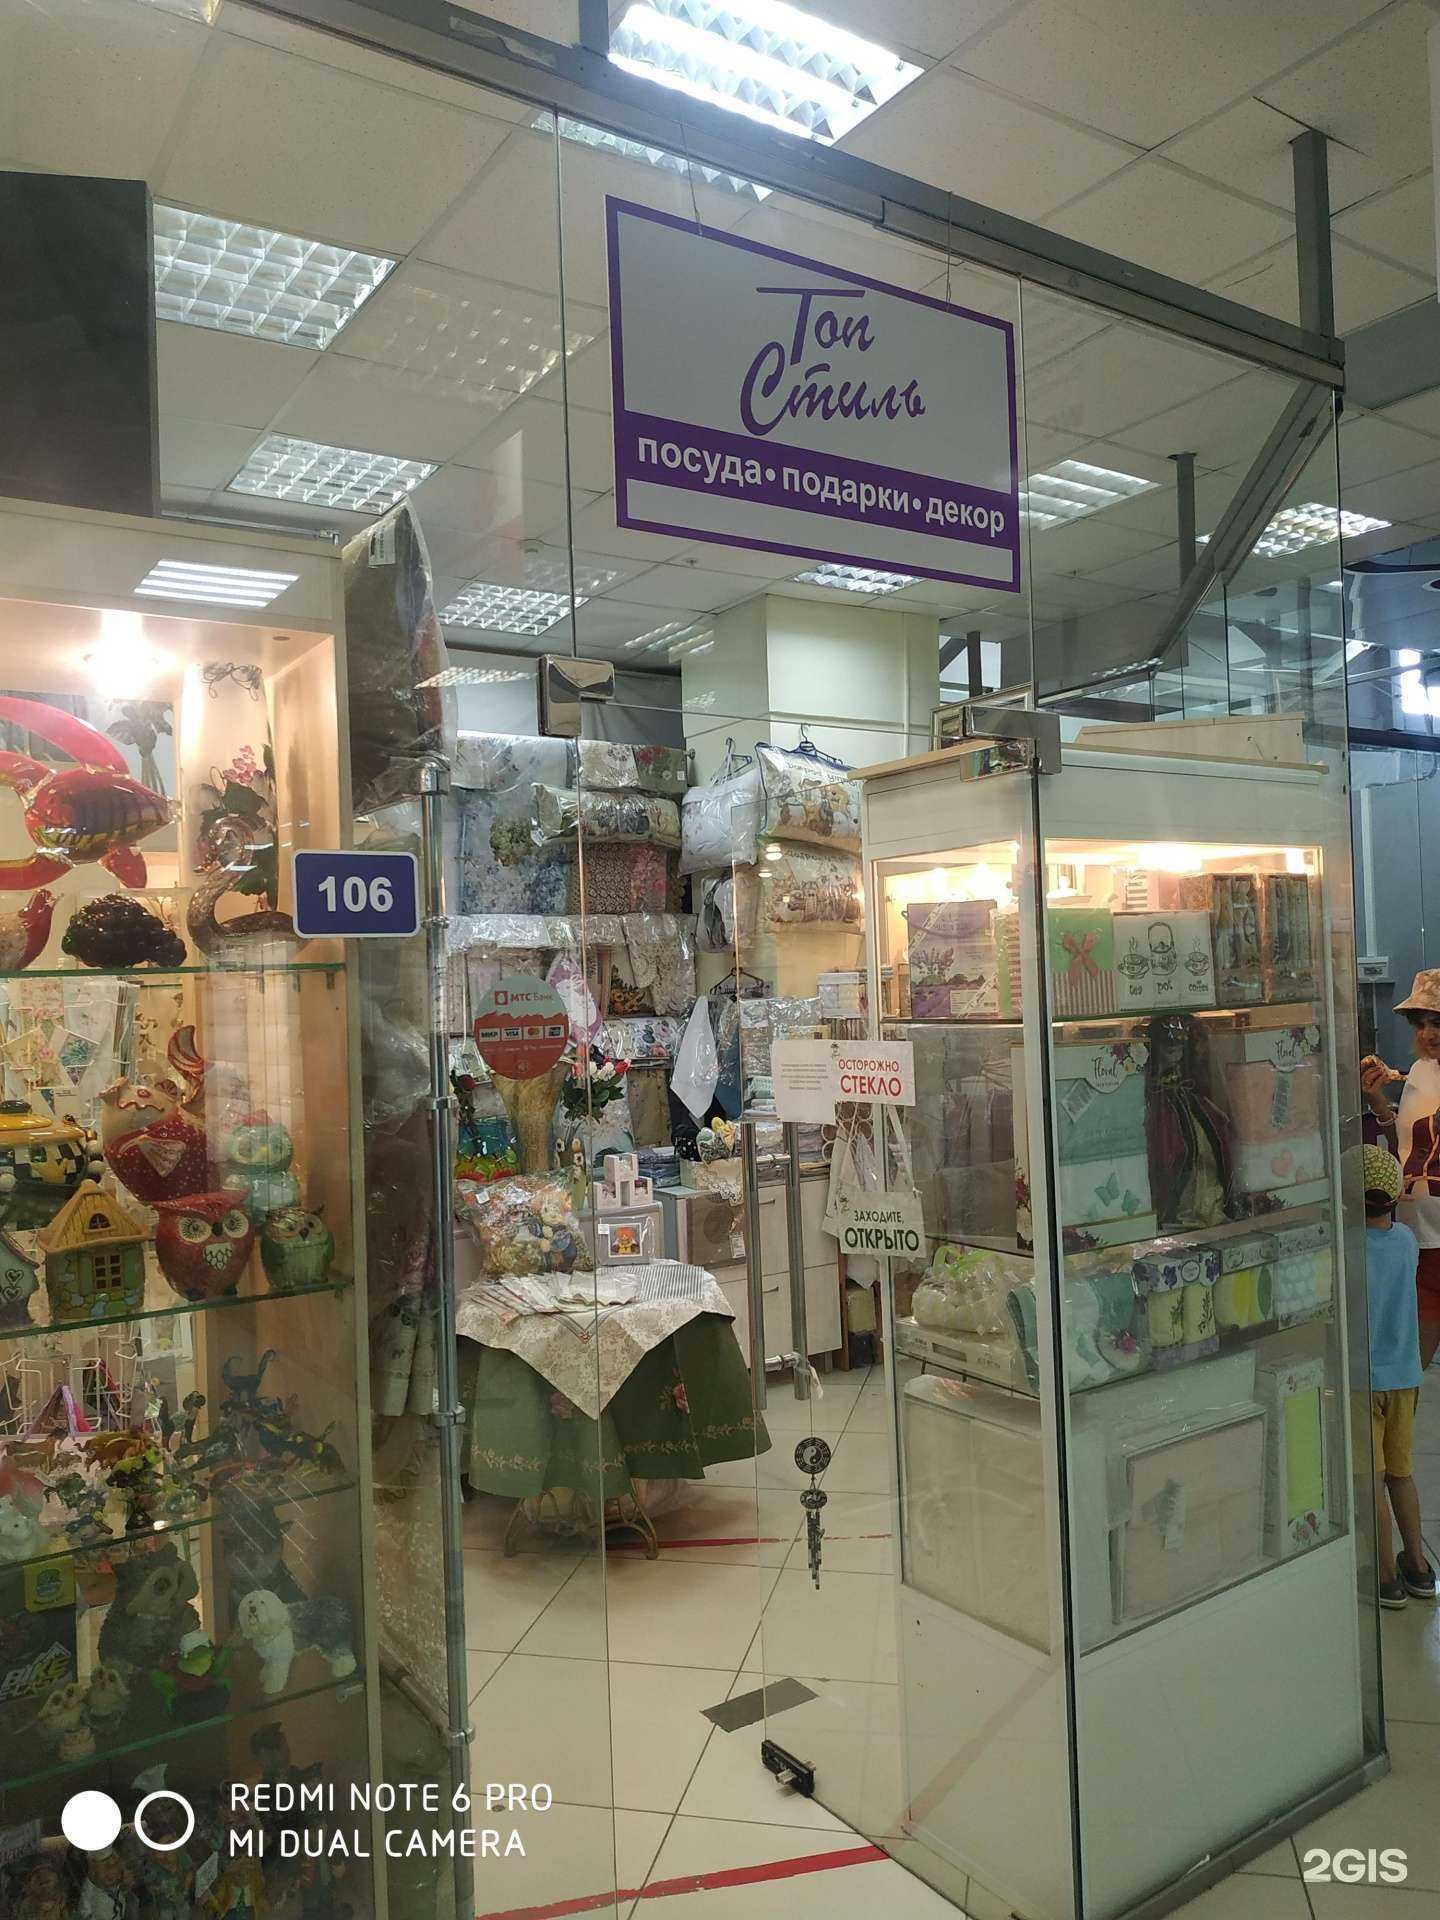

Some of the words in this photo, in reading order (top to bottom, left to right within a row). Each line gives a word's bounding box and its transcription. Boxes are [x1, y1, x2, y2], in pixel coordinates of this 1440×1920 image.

[756, 287, 876, 365] Топ
[740, 342, 926, 436] Стиль
[638, 437, 762, 487] посуда
[782, 466, 909, 513] подарки
[925, 497, 1005, 538] декор
[318, 876, 394, 912] 106
[840, 1074, 902, 1097] СТЕКЛО
[854, 1210, 904, 1224] ЗАХОДИТЕ,
[845, 1227, 919, 1251] ОТКРЫТО
